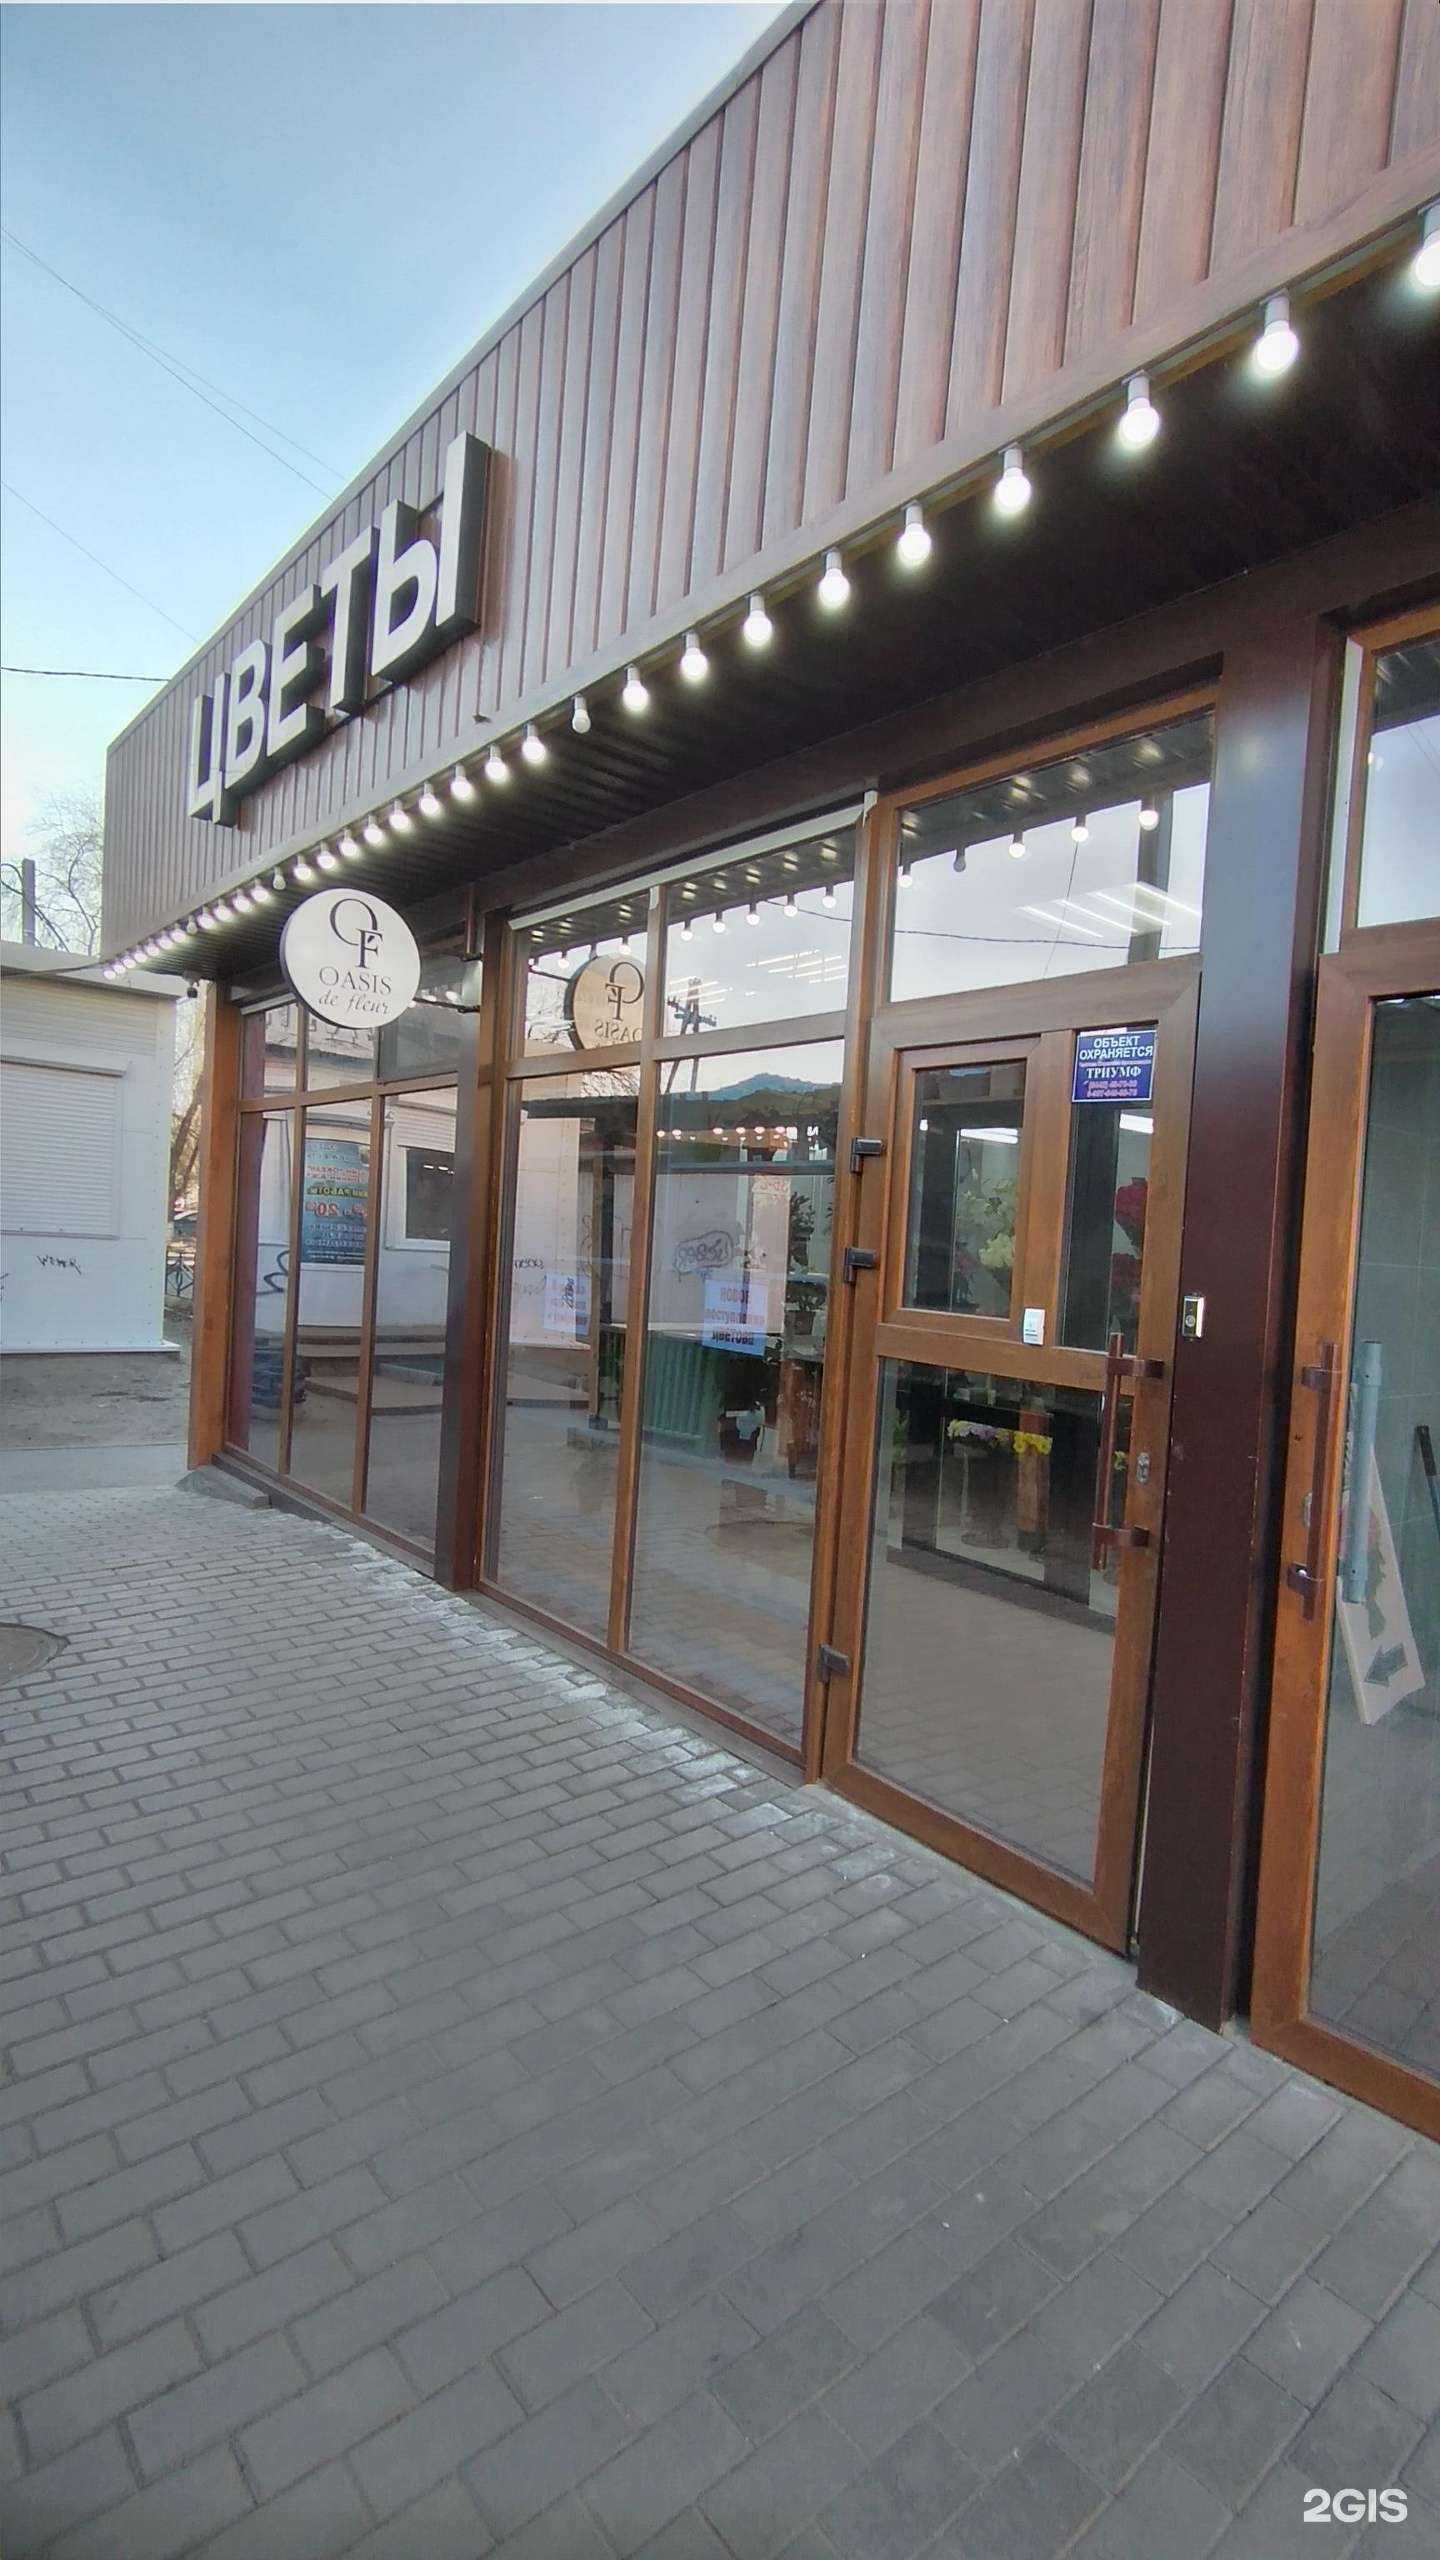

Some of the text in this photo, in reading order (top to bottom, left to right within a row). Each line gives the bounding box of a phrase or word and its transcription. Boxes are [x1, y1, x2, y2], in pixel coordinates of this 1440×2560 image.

[188, 431, 482, 826] ЦВЕТЫ
[319, 966, 393, 996] OASIS
[346, 993, 390, 1015] fleur
[1093, 1035, 1141, 1049] ОБЪЕКТ
[1079, 1045, 1154, 1060] ОХРАНЯЕТСЯ
[1086, 1065, 1142, 1079] ТРИУМФ
